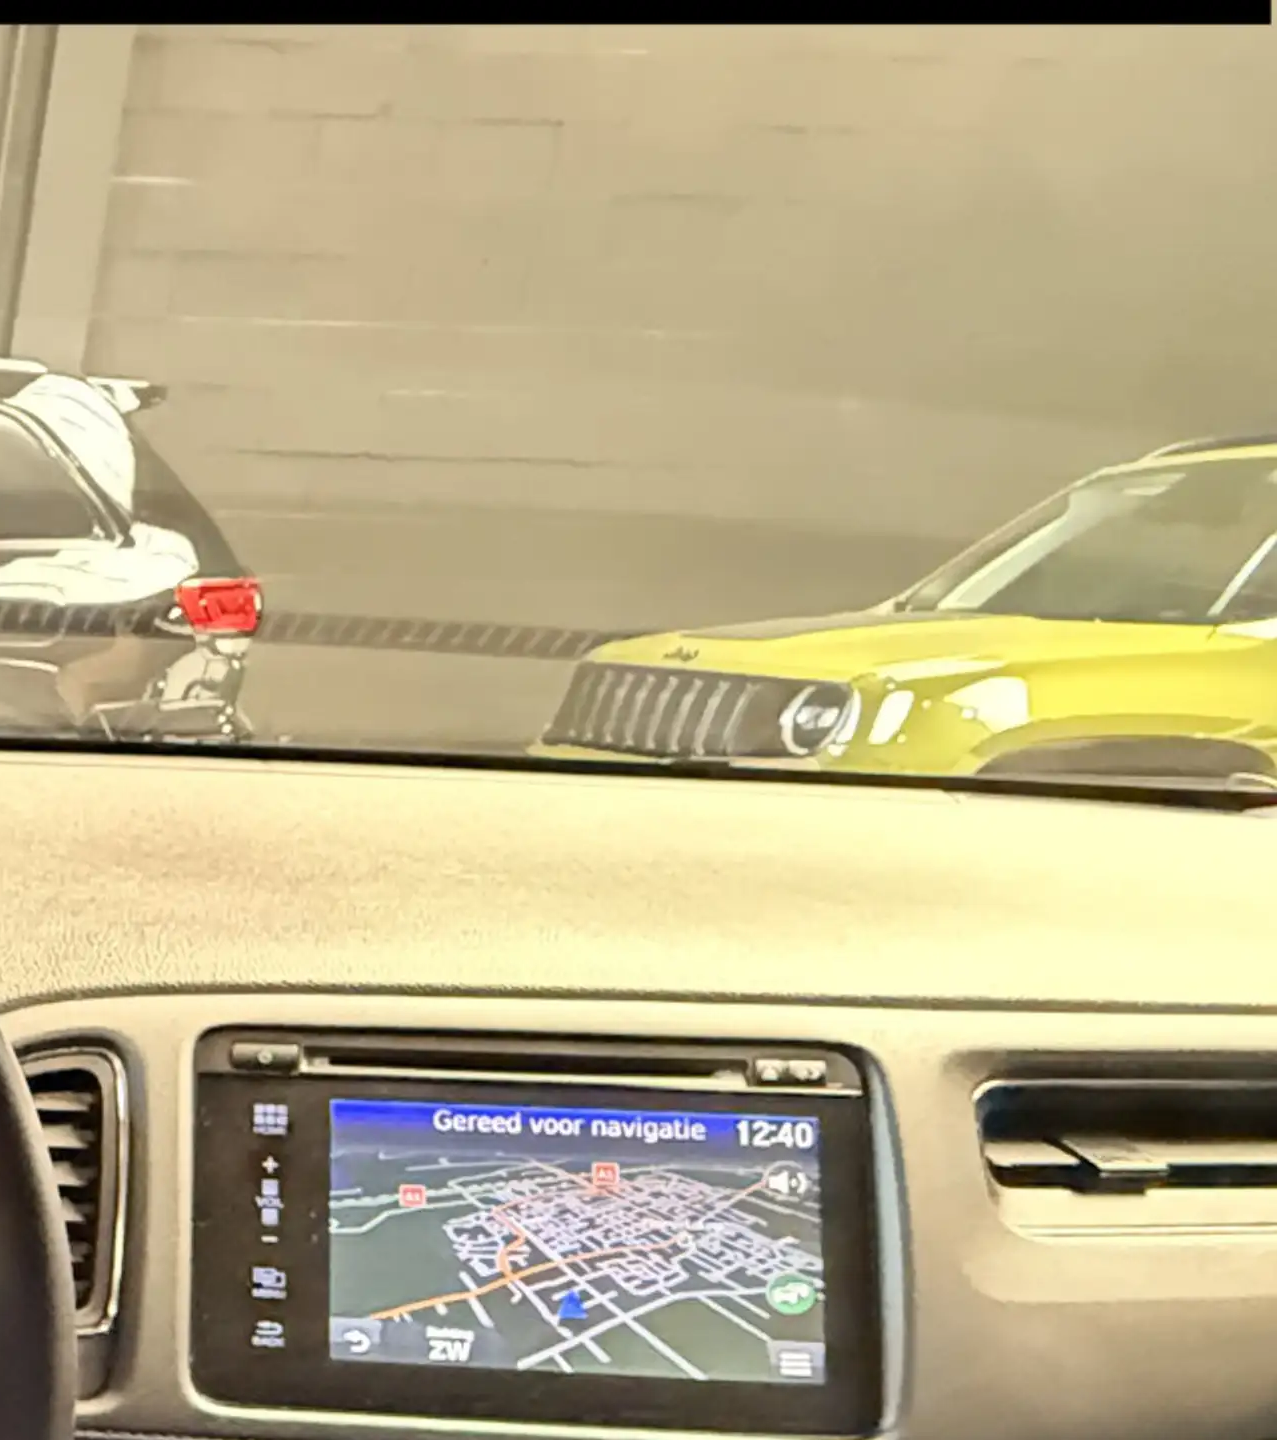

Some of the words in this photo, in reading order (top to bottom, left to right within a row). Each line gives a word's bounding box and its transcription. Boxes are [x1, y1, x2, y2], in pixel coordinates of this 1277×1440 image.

[432, 1108, 523, 1134] Gereed
[529, 1116, 585, 1137] voor
[590, 1114, 708, 1144] navigatie
[736, 1119, 815, 1150] 12:40
[428, 1339, 473, 1362] ZW
